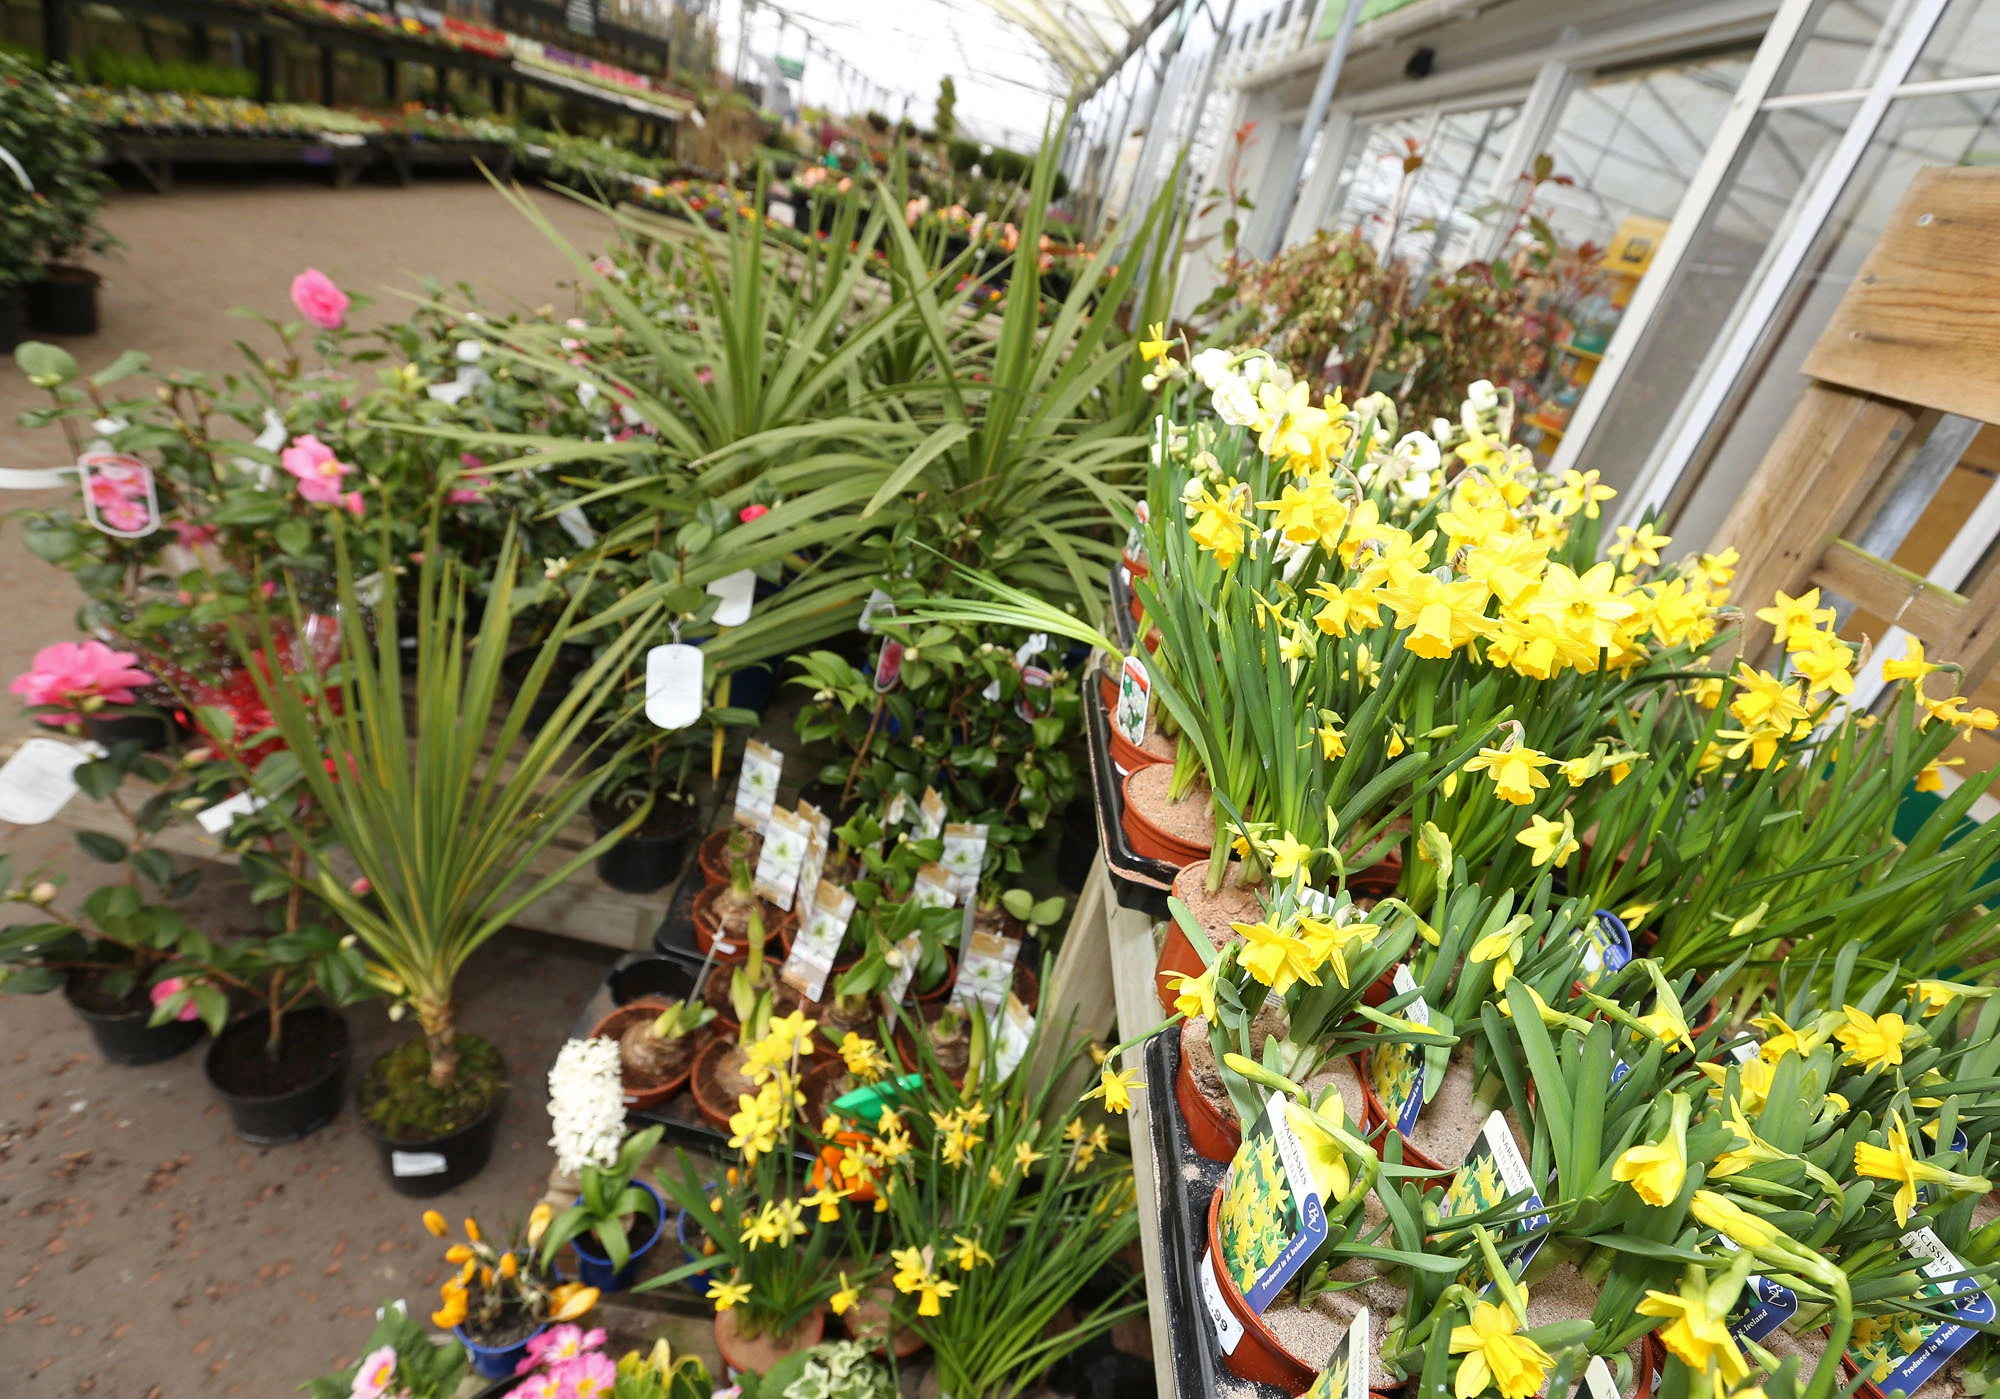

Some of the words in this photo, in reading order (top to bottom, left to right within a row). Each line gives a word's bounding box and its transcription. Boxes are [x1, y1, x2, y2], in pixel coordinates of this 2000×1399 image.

[1281, 1114, 1307, 1186] NARCISSUS
[1260, 1264, 1282, 1291] Produced
[1280, 1258, 1288, 1270] in
[1290, 1233, 1308, 1255] Ireland
[1916, 1228, 1955, 1273] RCISSUS
[1743, 1308, 1769, 1332] Ireland
[1902, 1349, 1931, 1378] Produced
[1930, 1343, 1938, 1354] in
[1935, 1333, 1945, 1348] N.
